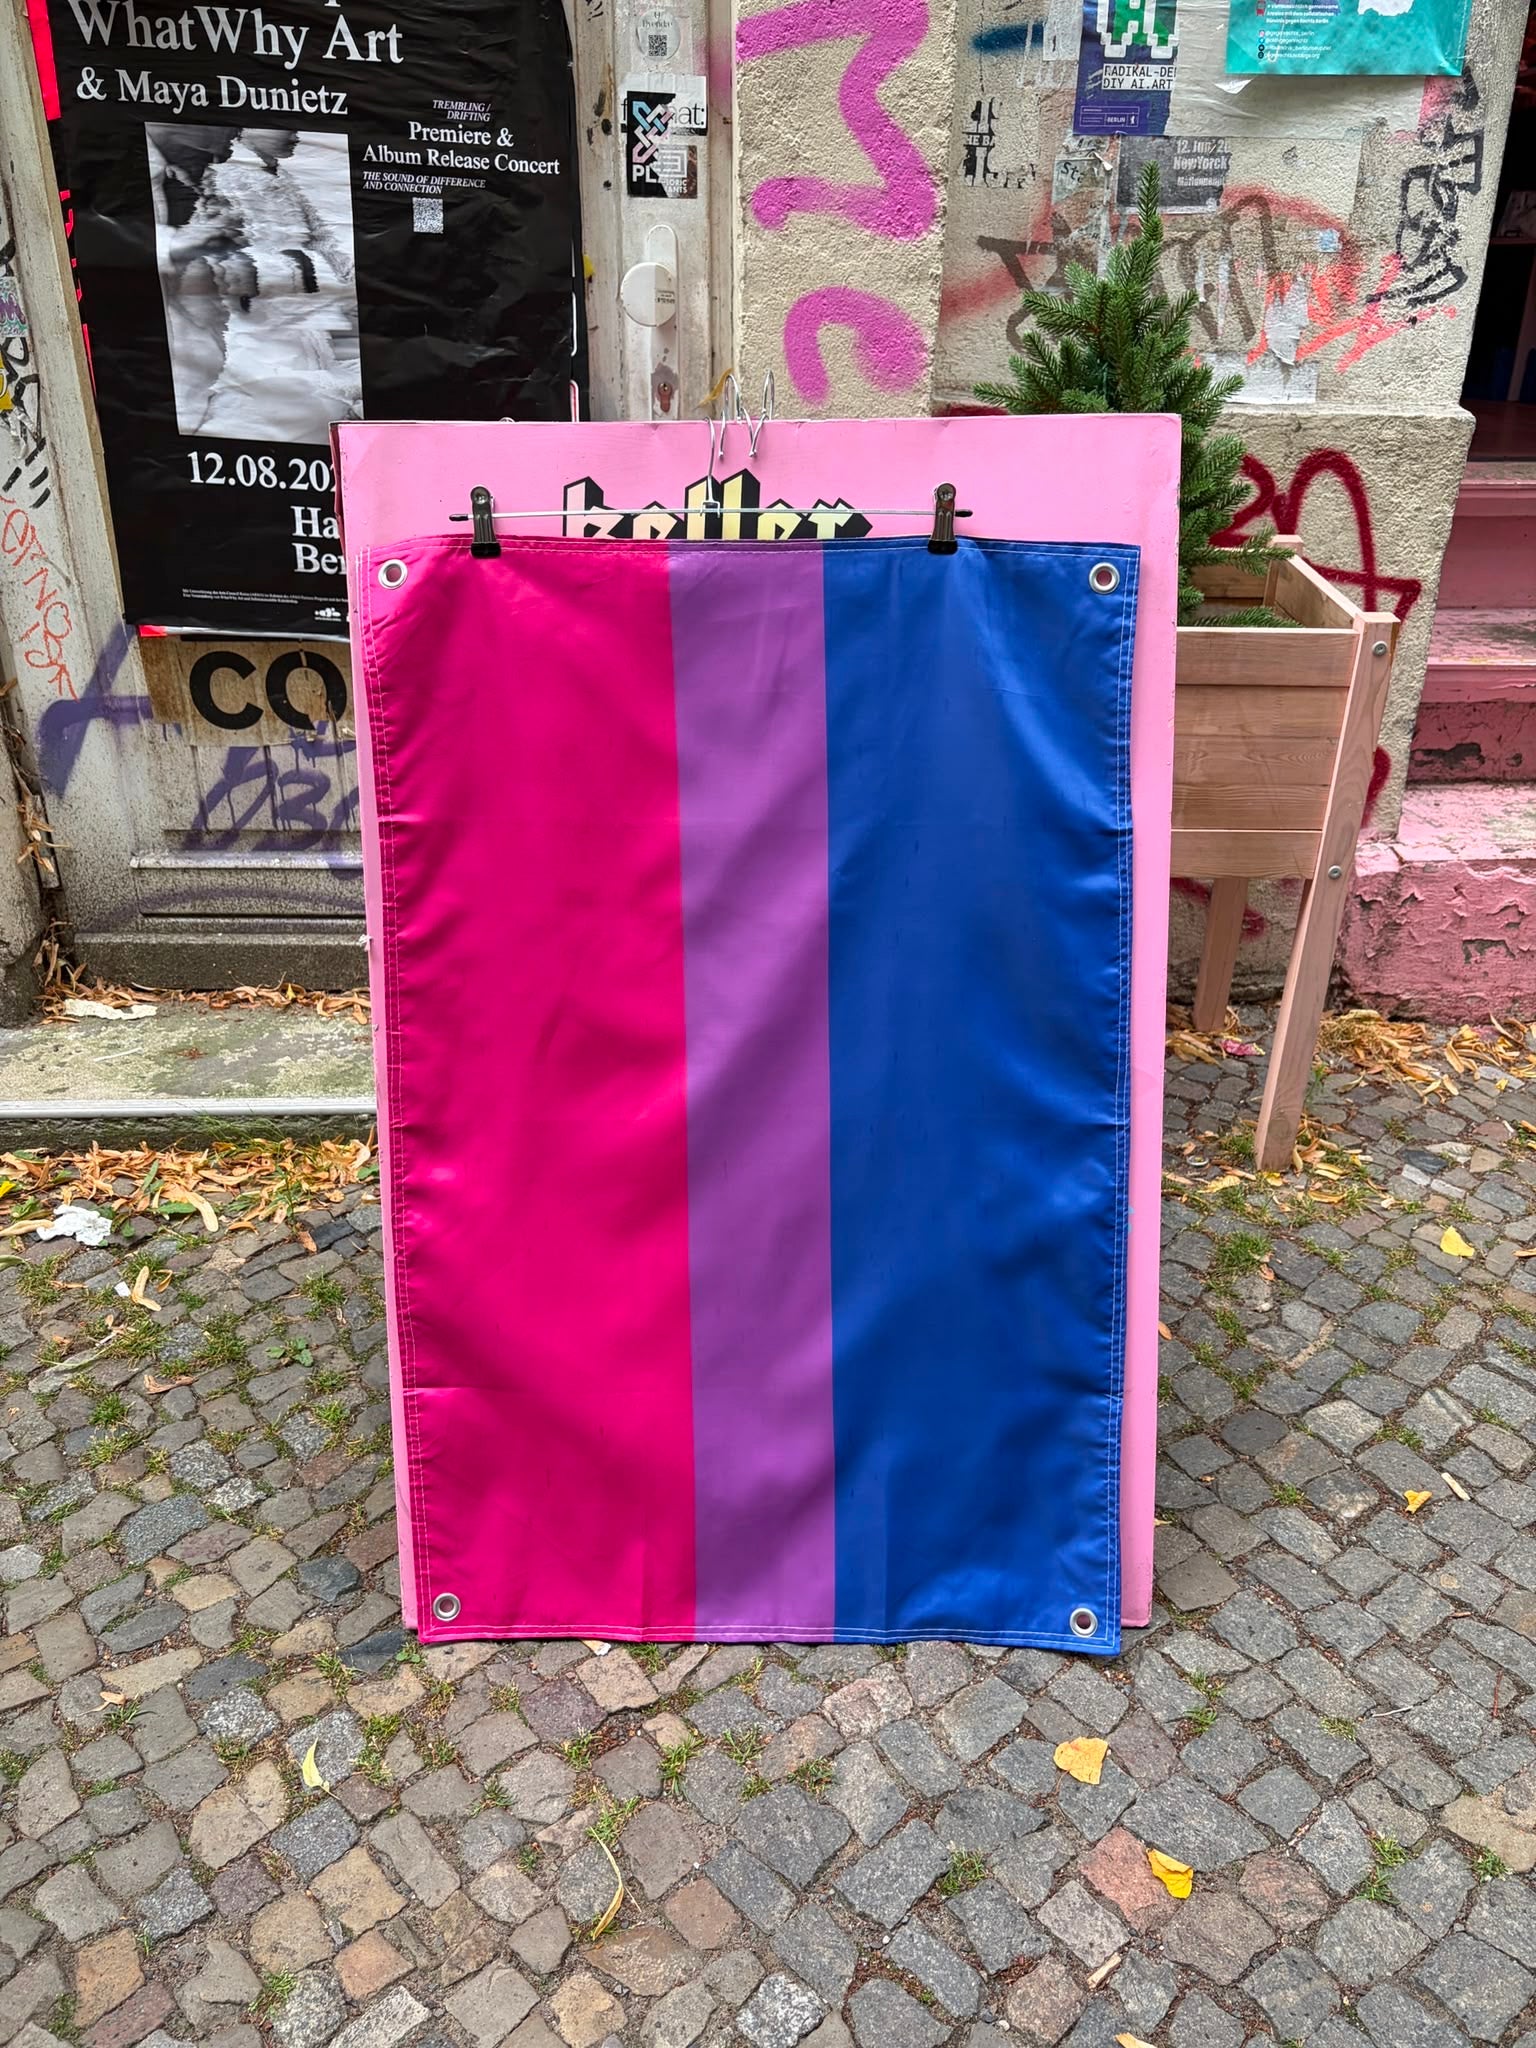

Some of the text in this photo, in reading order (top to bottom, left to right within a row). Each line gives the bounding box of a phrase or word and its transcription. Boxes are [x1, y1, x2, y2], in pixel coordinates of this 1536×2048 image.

[67, 0, 405, 70] WhatWhy Art
[76, 66, 348, 115] & Maya Dunietz
[1103, 78, 1124, 89] DIY
[432, 100, 485, 112] TREMBLING
[447, 110, 491, 122] DRIFTING
[408, 121, 514, 147] Premiere &
[362, 144, 561, 175] Album Release Concert
[363, 171, 486, 188] THE SOUND OF DIFFERENCE
[363, 180, 443, 194] AND CONNECTION
[290, 505, 341, 540] Ha
[189, 650, 348, 731] CO
